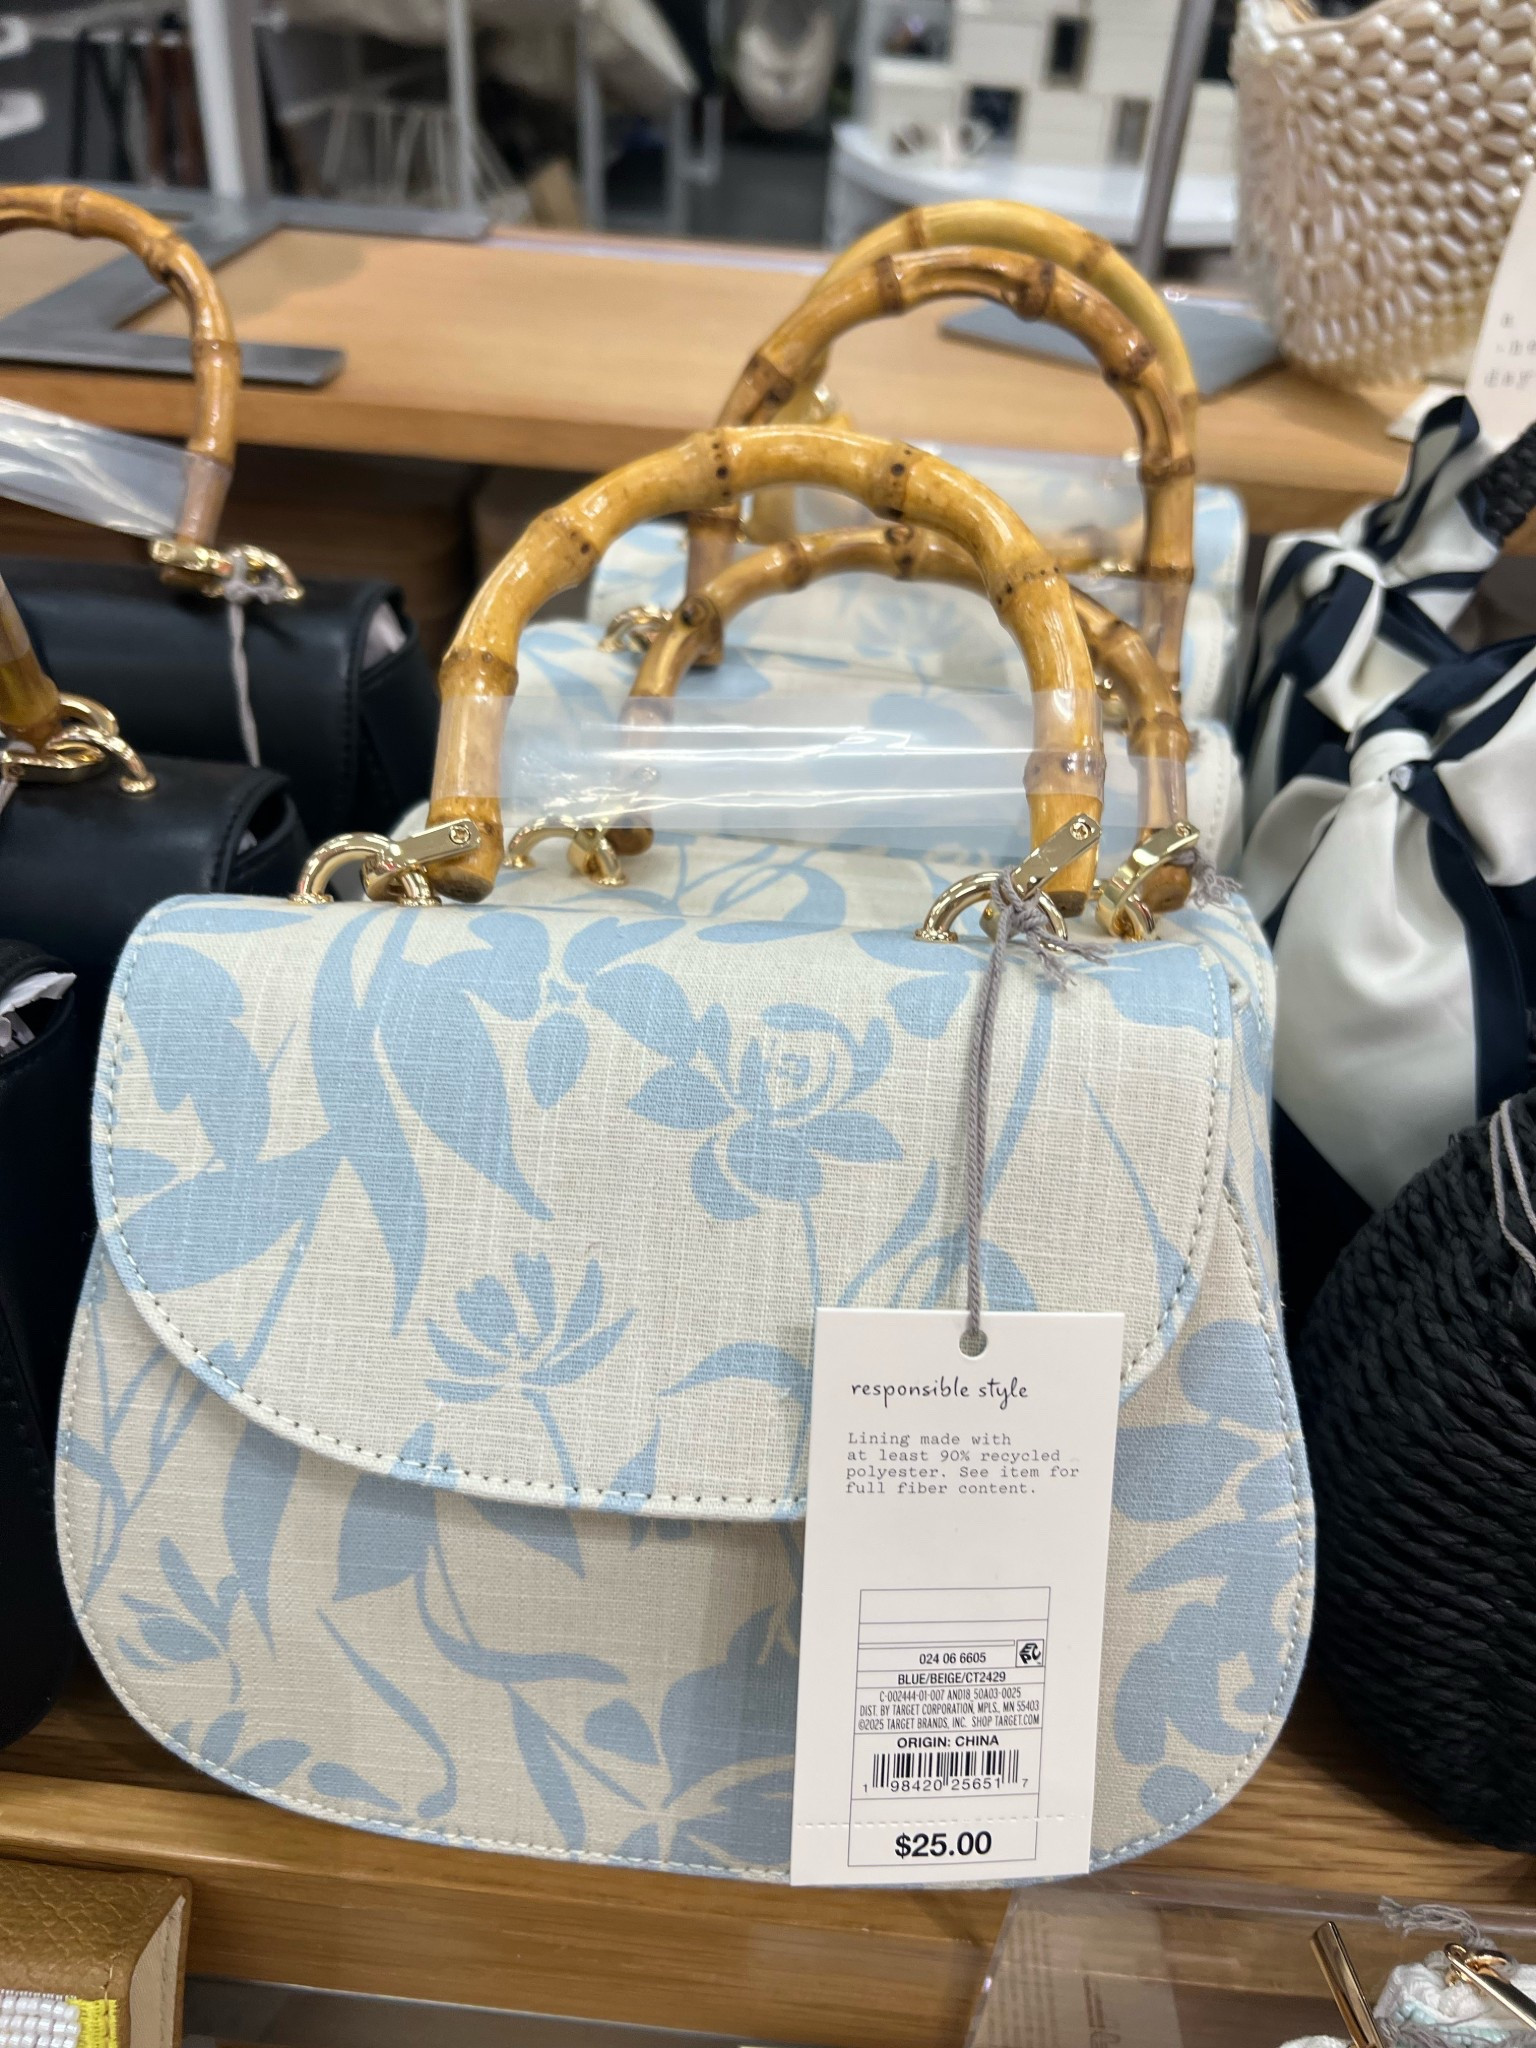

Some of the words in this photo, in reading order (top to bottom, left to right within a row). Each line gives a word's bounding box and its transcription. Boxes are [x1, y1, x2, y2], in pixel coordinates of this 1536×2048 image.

[851, 1375, 970, 1408] responsible
[978, 1377, 1029, 1410] style
[848, 1432, 911, 1447] Lining
[920, 1432, 960, 1446] made
[971, 1432, 1012, 1446] with
[847, 1450, 867, 1462] at
[880, 1449, 929, 1462] least
[940, 1449, 971, 1462] 90%
[980, 1449, 1061, 1464] recycled
[846, 1465, 947, 1480] polyester.
[959, 1465, 989, 1478] See
[1000, 1465, 1040, 1478] item
[1050, 1465, 1080, 1478] for
[845, 1481, 886, 1494] full
[897, 1481, 948, 1494] fiber
[958, 1482, 1036, 1494] content.
[919, 1653, 940, 1665] 024
[943, 1652, 957, 1664] 06
[960, 1652, 987, 1664] 6605
[897, 1671, 1006, 1685] BLUE/BEIGE/CT2429
[860, 1705, 878, 1717] DIST.
[880, 1704, 891, 1716] BY
[892, 1703, 920, 1716] TARGET
[922, 1702, 974, 1716] CORPORATION,
[1003, 1701, 1015, 1713] MN
[1017, 1700, 1040, 1712] 55403
[887, 1717, 915, 1730] TARGET
[917, 1716, 950, 1730] BRANDS,
[952, 1716, 967, 1729] INC.
[972, 1715, 993, 1728] SHOP
[995, 1714, 1040, 1727] TARGET.COM
[897, 1737, 951, 1749] ORIGIN:
[955, 1735, 999, 1747] CHINA
[863, 1784, 868, 1793] 1
[890, 1780, 943, 1792] 98420
[951, 1778, 1001, 1791] 25651
[1022, 1779, 1029, 1788] 7
[895, 1830, 992, 1859] $25.00
